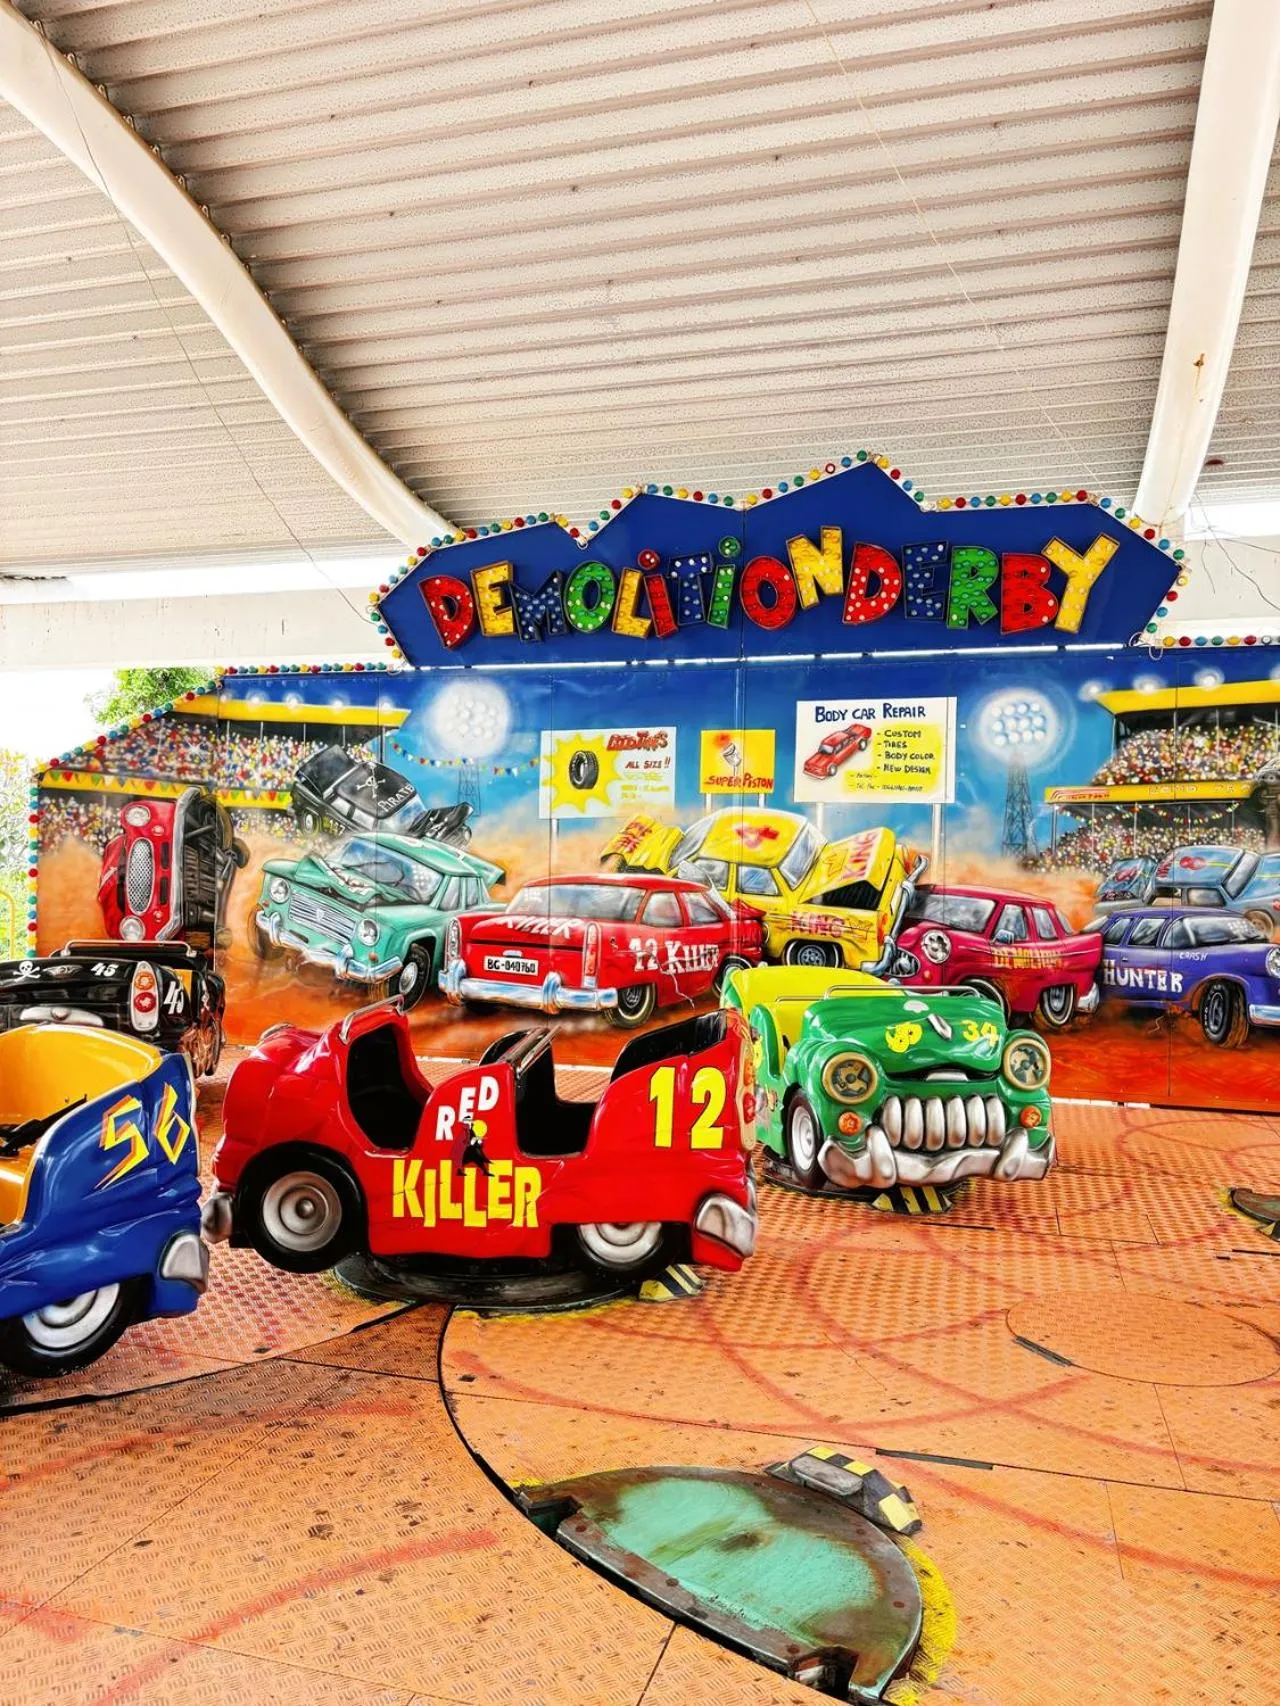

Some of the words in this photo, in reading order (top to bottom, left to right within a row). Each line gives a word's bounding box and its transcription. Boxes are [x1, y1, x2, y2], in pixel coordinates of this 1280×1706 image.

[815, 706, 848, 722] BODY
[852, 709, 876, 720] CAR
[882, 703, 926, 718] REPAIR
[884, 730, 921, 738] CUSTOM
[884, 740, 908, 748] TIRES
[625, 760, 640, 769] ALL
[884, 752, 907, 760] BODY
[377, 783, 415, 813] PIRATE
[90, 962, 119, 977] 45
[1102, 958, 1184, 993] HUNTER
[960, 1019, 1000, 1048] 34
[435, 1076, 500, 1141] RED
[649, 1066, 727, 1150] 12
[94, 1082, 191, 1192] 56
[392, 1159, 542, 1228] KILLER
